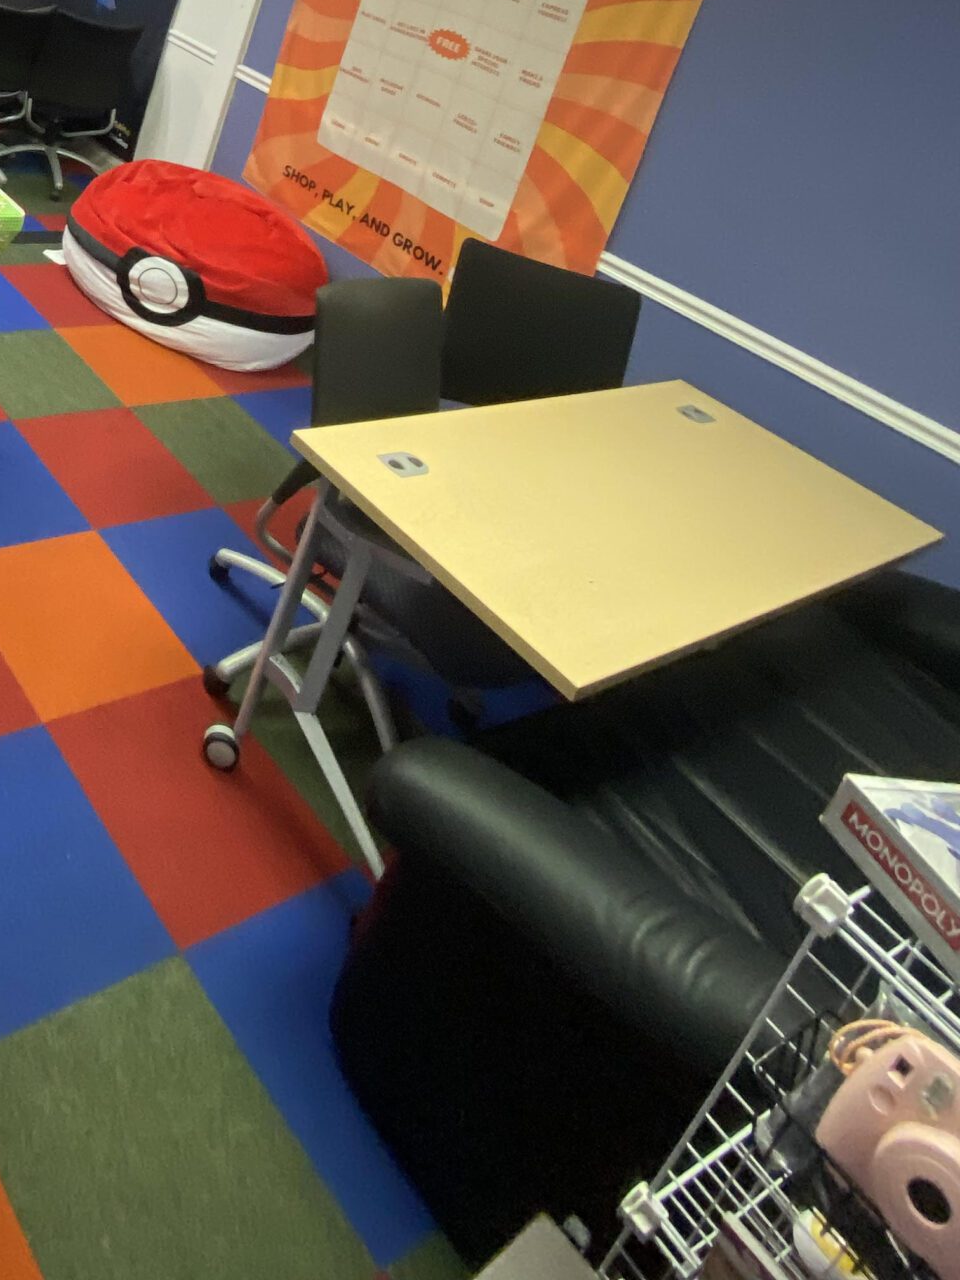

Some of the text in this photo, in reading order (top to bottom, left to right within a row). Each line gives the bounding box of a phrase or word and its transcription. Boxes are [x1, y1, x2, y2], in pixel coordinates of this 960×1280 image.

[436, 35, 462, 54] FREE
[282, 164, 444, 276] SHOP, PLAY, AND GROW.
[847, 811, 960, 938] MONOPOLY
